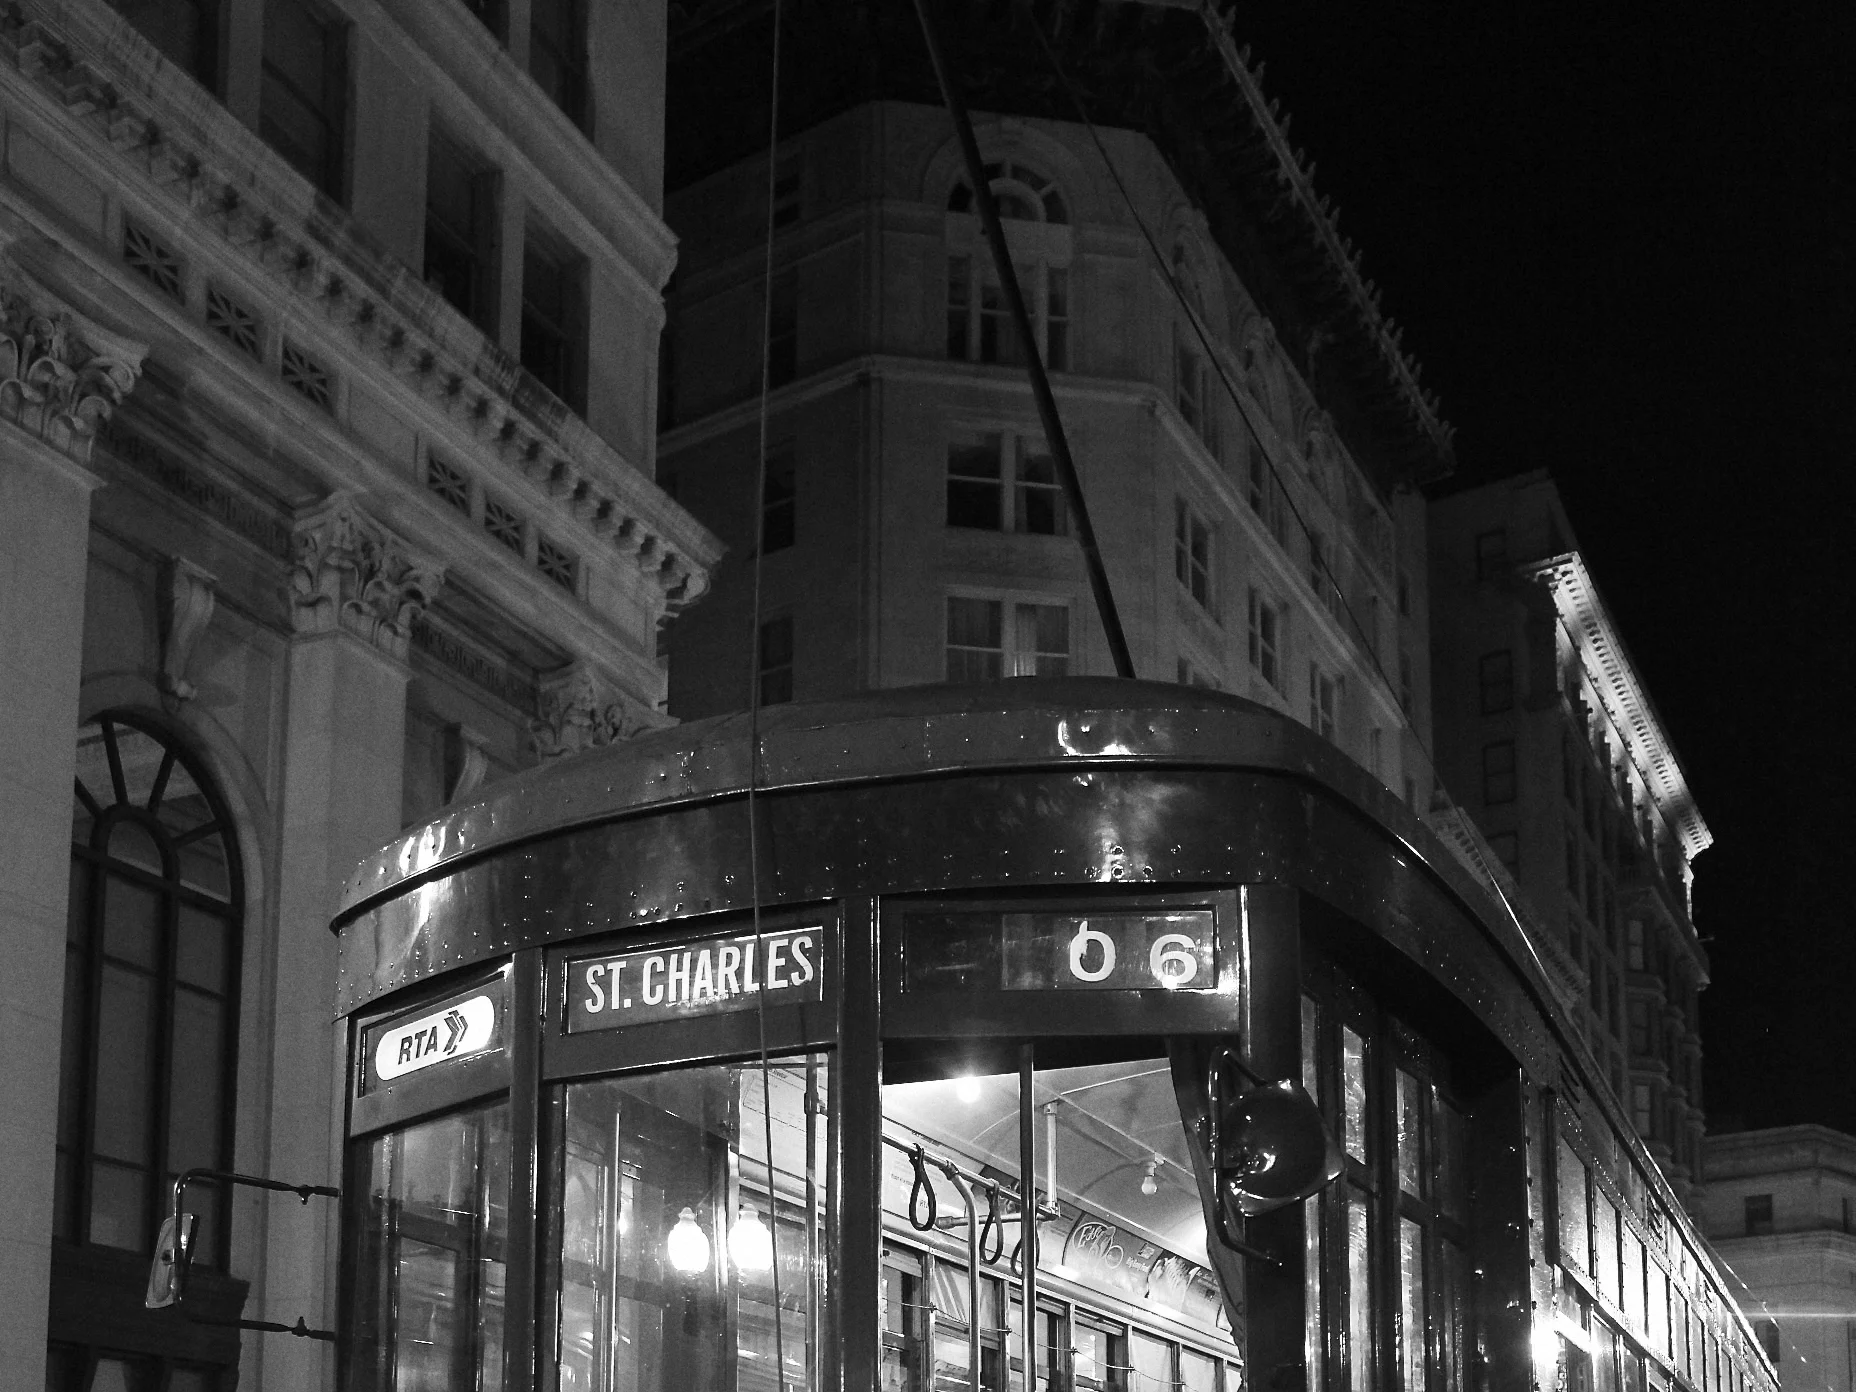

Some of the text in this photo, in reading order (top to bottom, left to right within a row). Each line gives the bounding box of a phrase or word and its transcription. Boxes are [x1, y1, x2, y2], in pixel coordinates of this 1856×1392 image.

[585, 936, 814, 1014] ST. CHARLES
[398, 1025, 438, 1065] RTA
